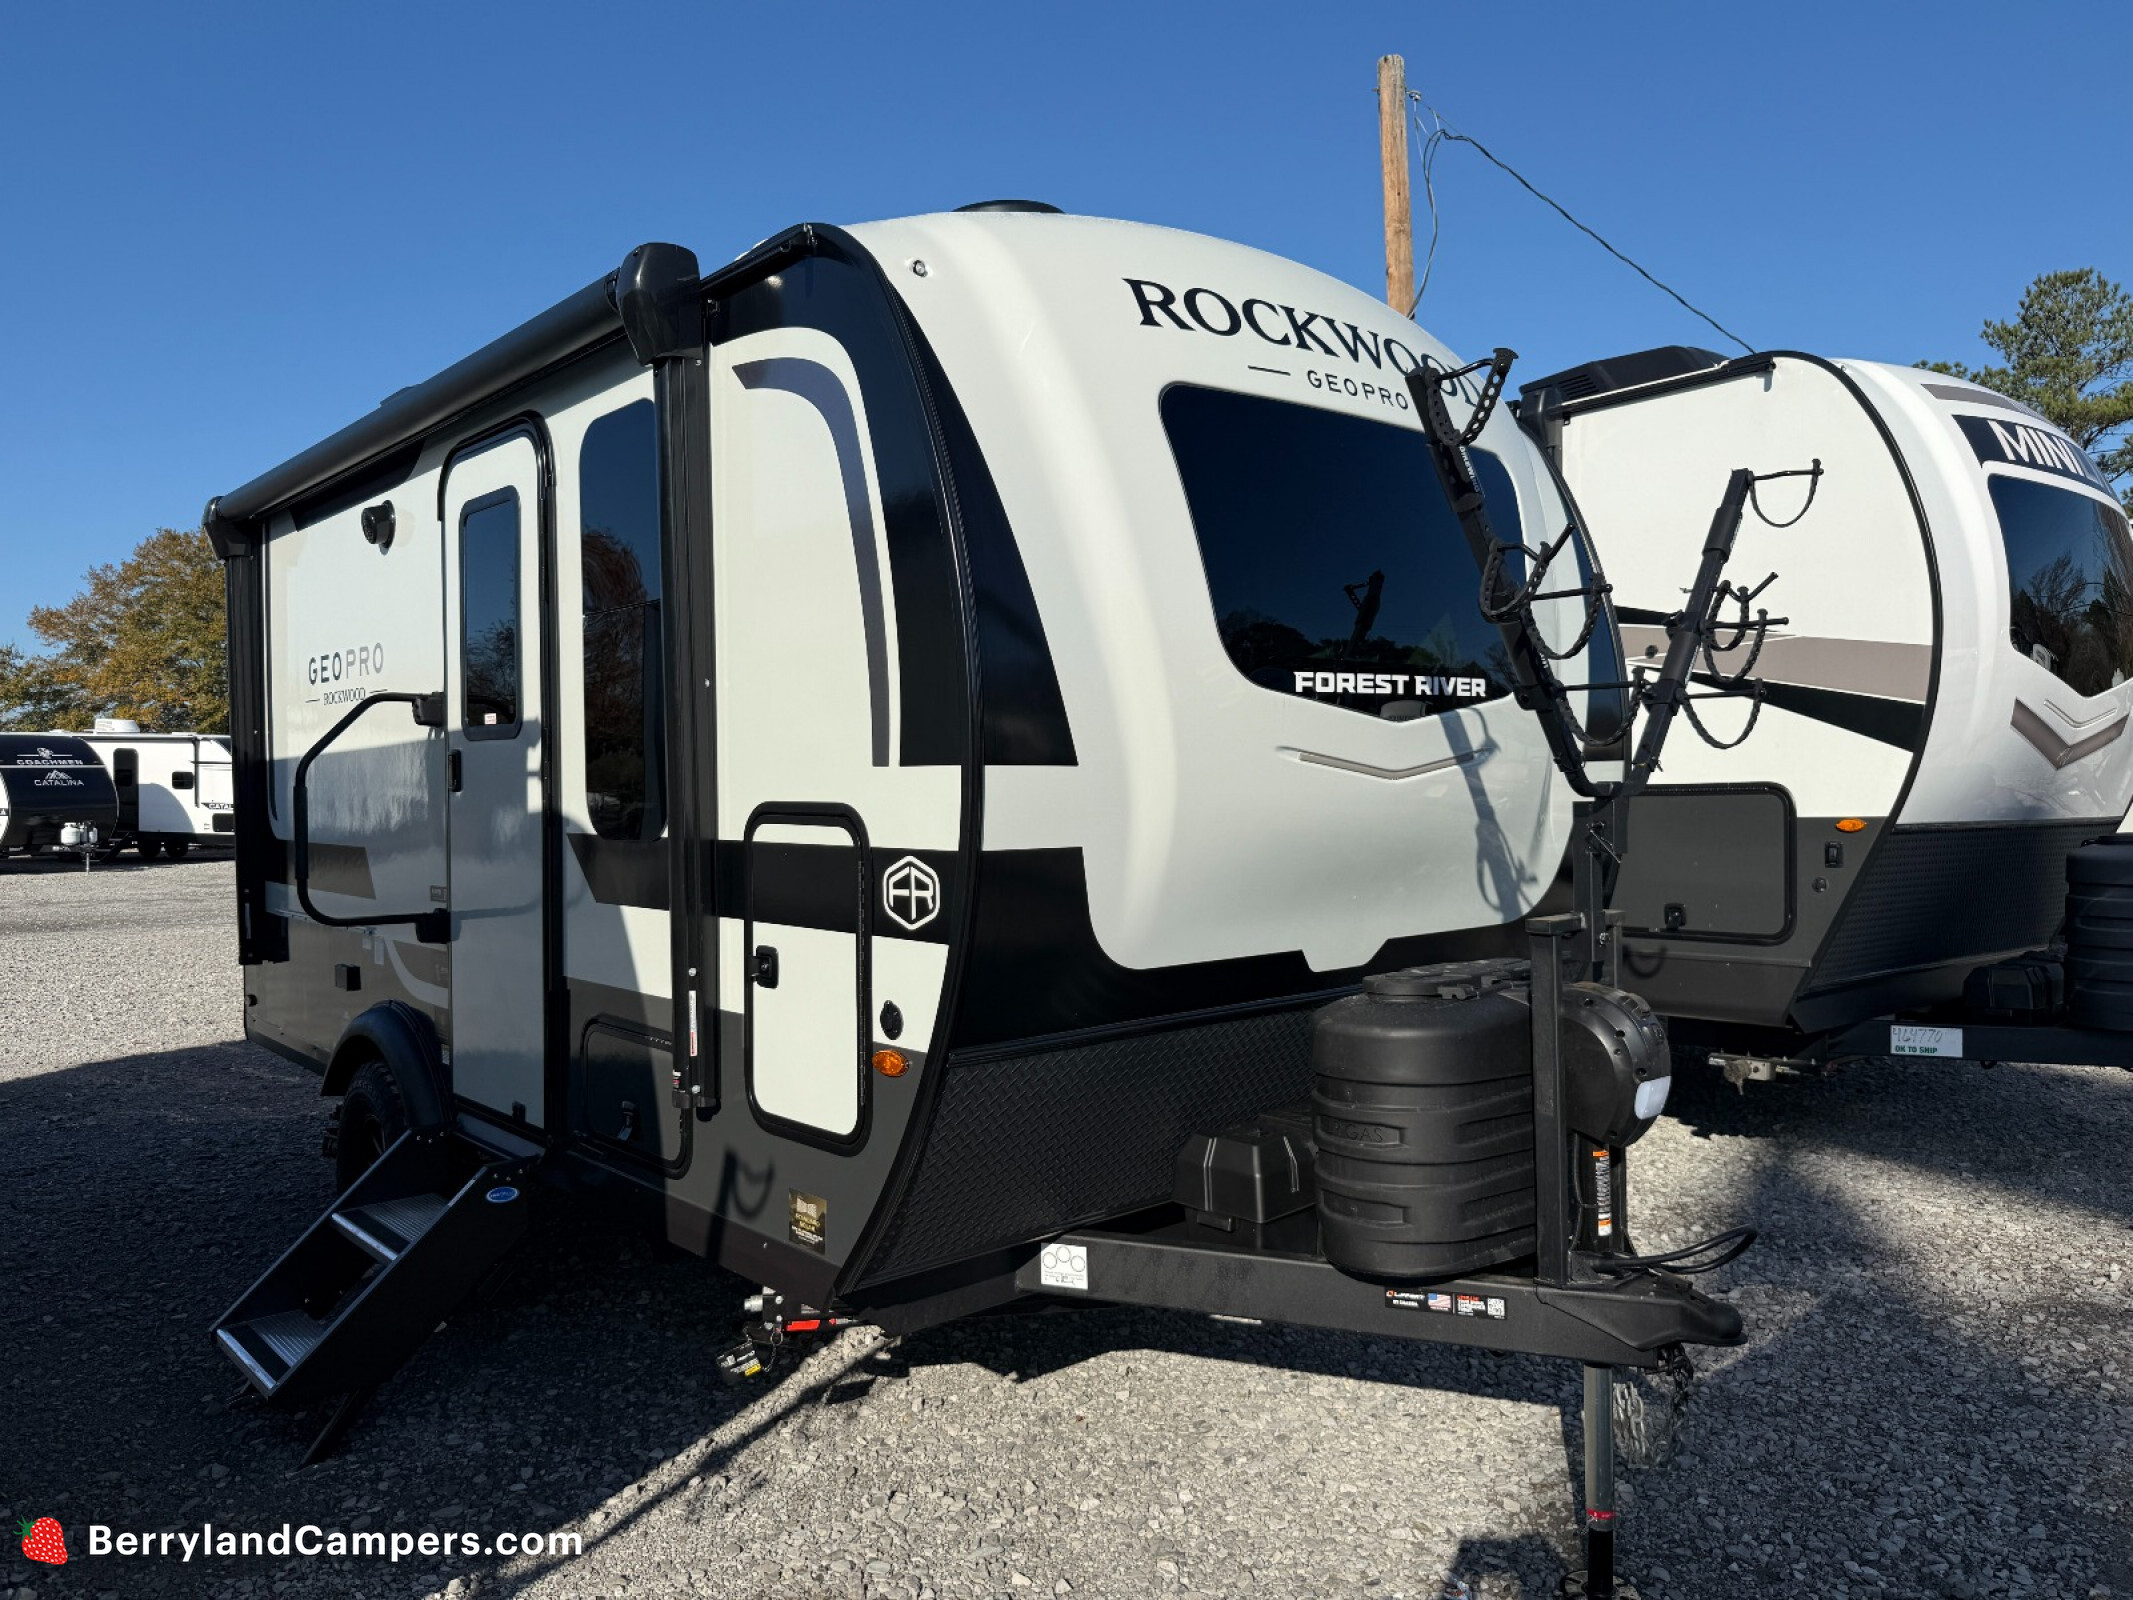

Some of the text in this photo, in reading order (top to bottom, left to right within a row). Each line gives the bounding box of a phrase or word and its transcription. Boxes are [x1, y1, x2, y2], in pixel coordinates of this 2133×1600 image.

[1121, 277, 1481, 409] ROCKWOOD
[1306, 369, 1409, 411] GEOPRO
[308, 642, 384, 686] GEOPRO
[1293, 671, 1487, 697] FOREST RIVER
[323, 687, 366, 706] ROCKWOOD
[34, 779, 85, 787] CATALINA
[1895, 1045, 1906, 1053] OK
[1920, 1046, 1938, 1054] SHIP
[1345, 1124, 1384, 1143] GAS
